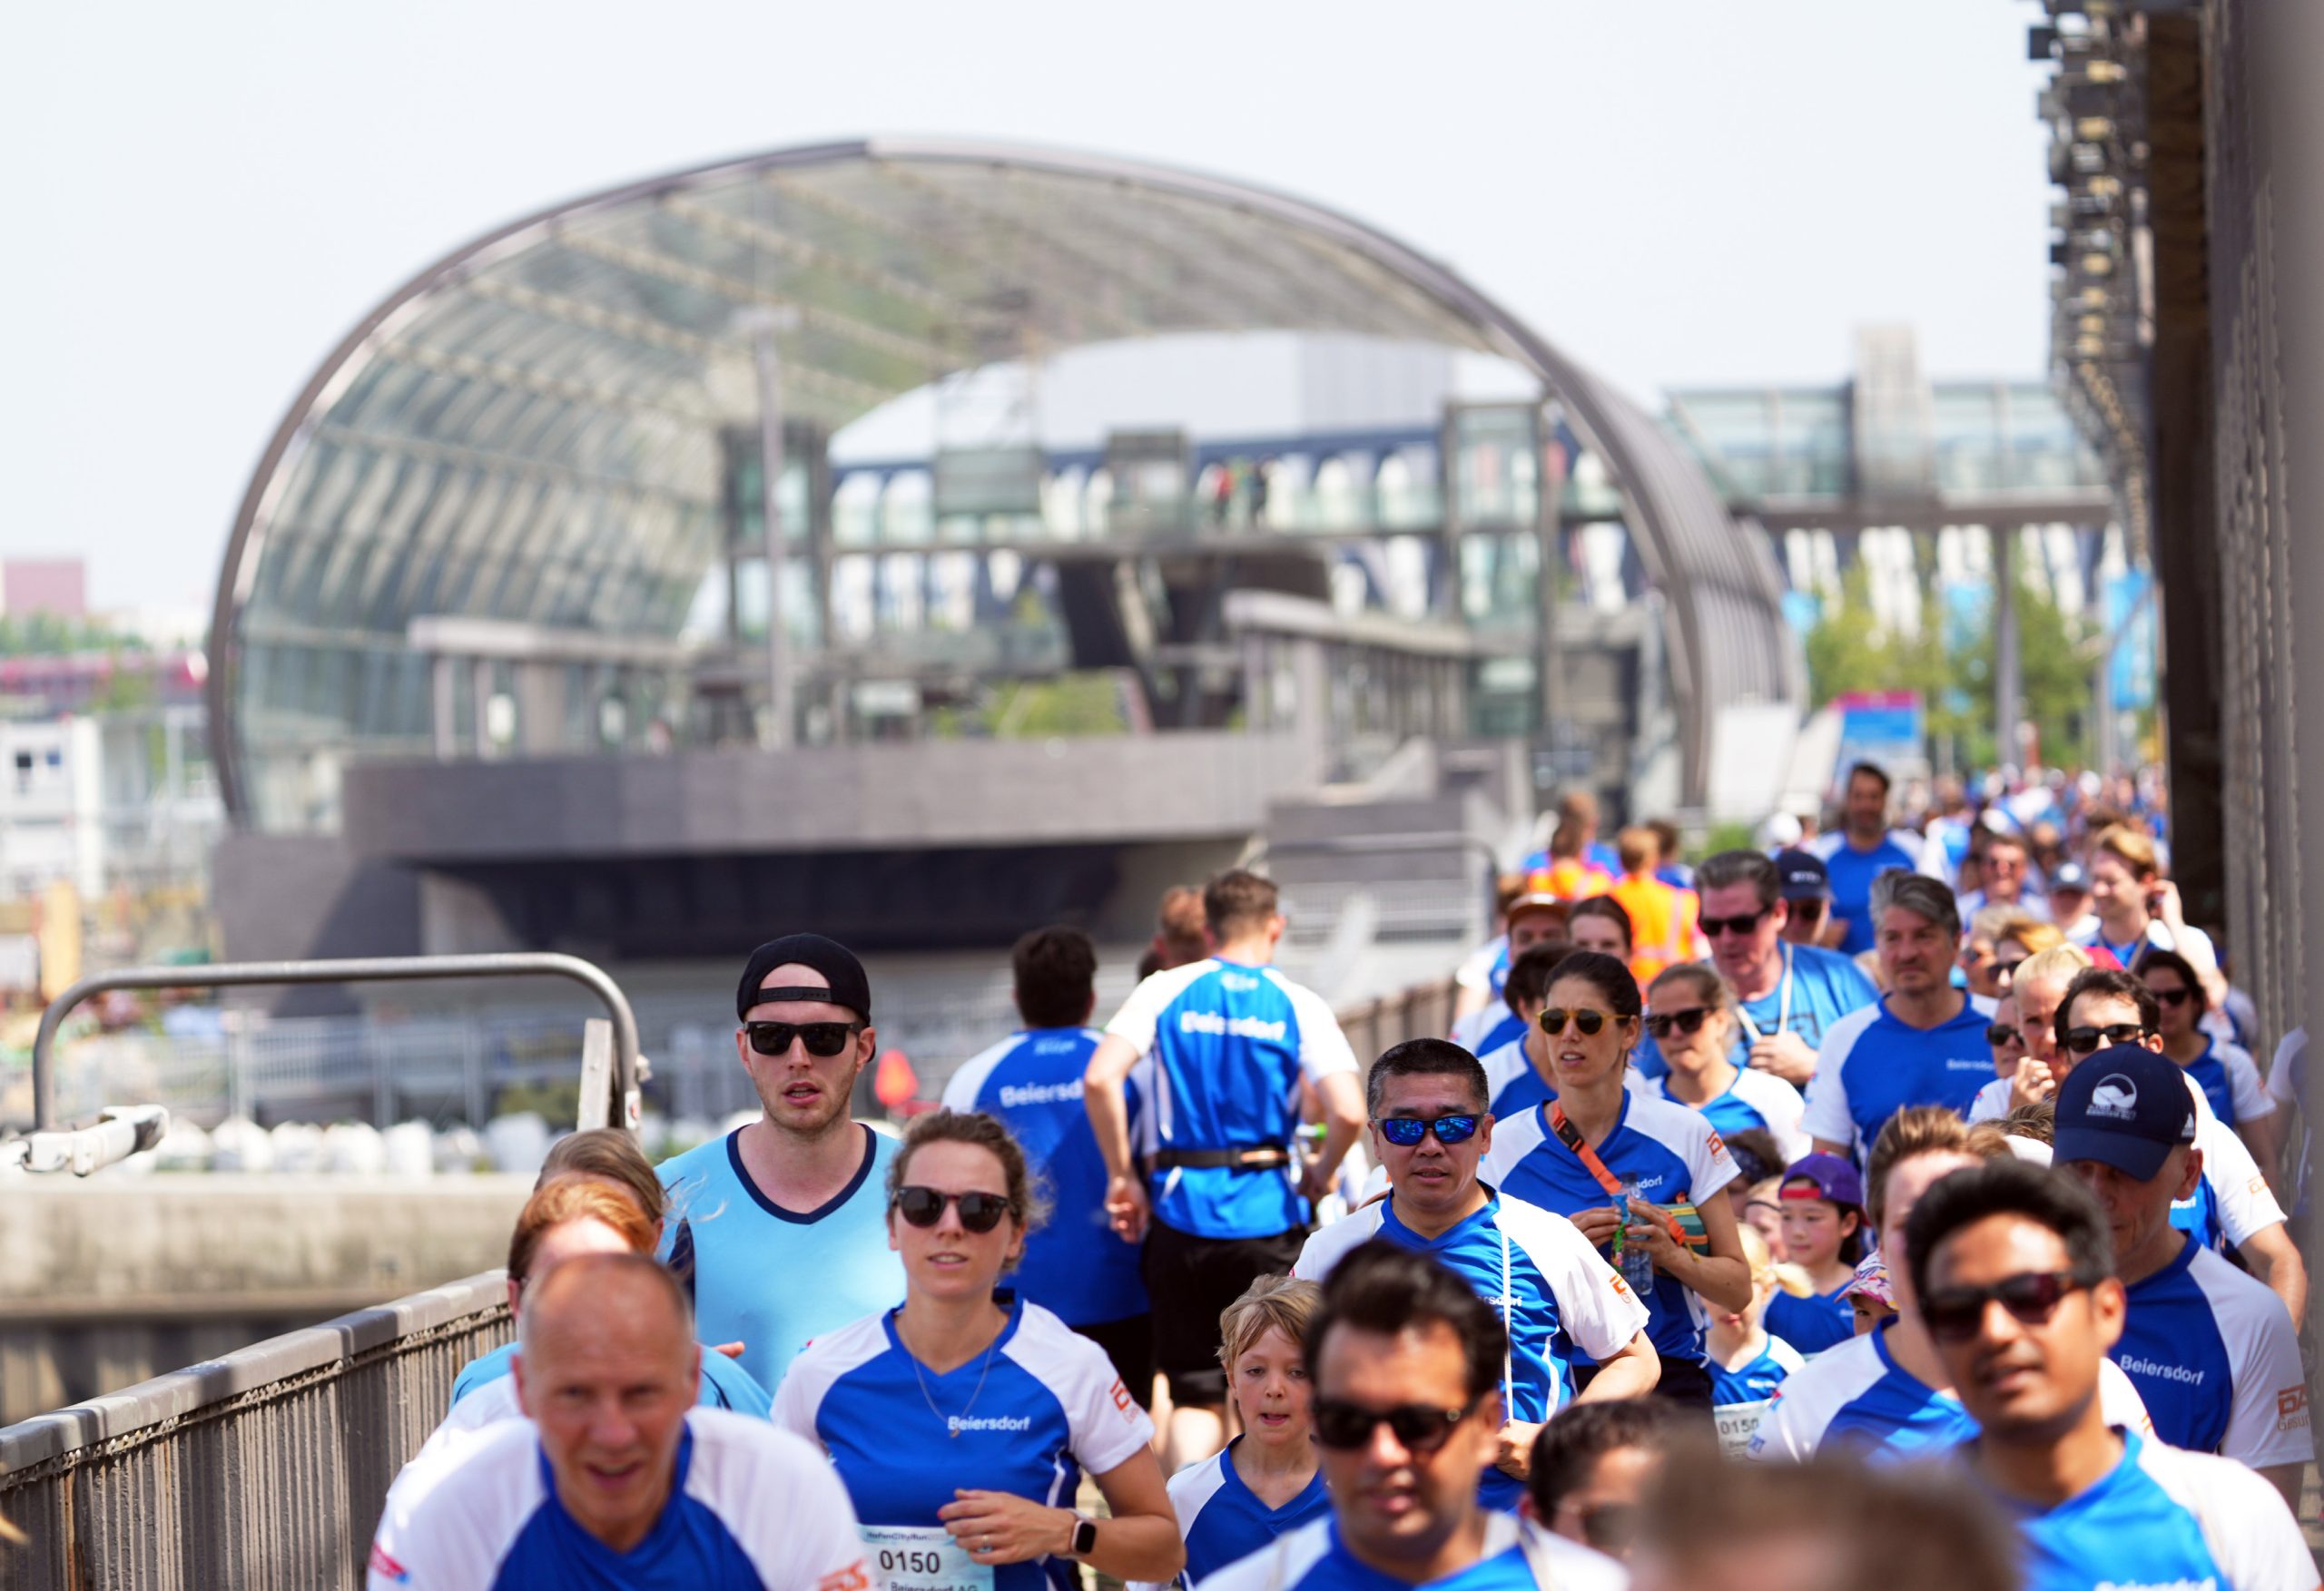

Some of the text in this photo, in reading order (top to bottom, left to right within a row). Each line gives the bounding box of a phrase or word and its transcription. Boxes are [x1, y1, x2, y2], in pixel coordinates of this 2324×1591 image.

[1181, 1010, 1285, 1042] Beiesdorf
[999, 1077, 1085, 1107] Beiersd
[2120, 1353, 2205, 1386] Beiersdorf
[947, 1415, 1031, 1431] Beiersdorf
[879, 1549, 940, 1574] 0150
